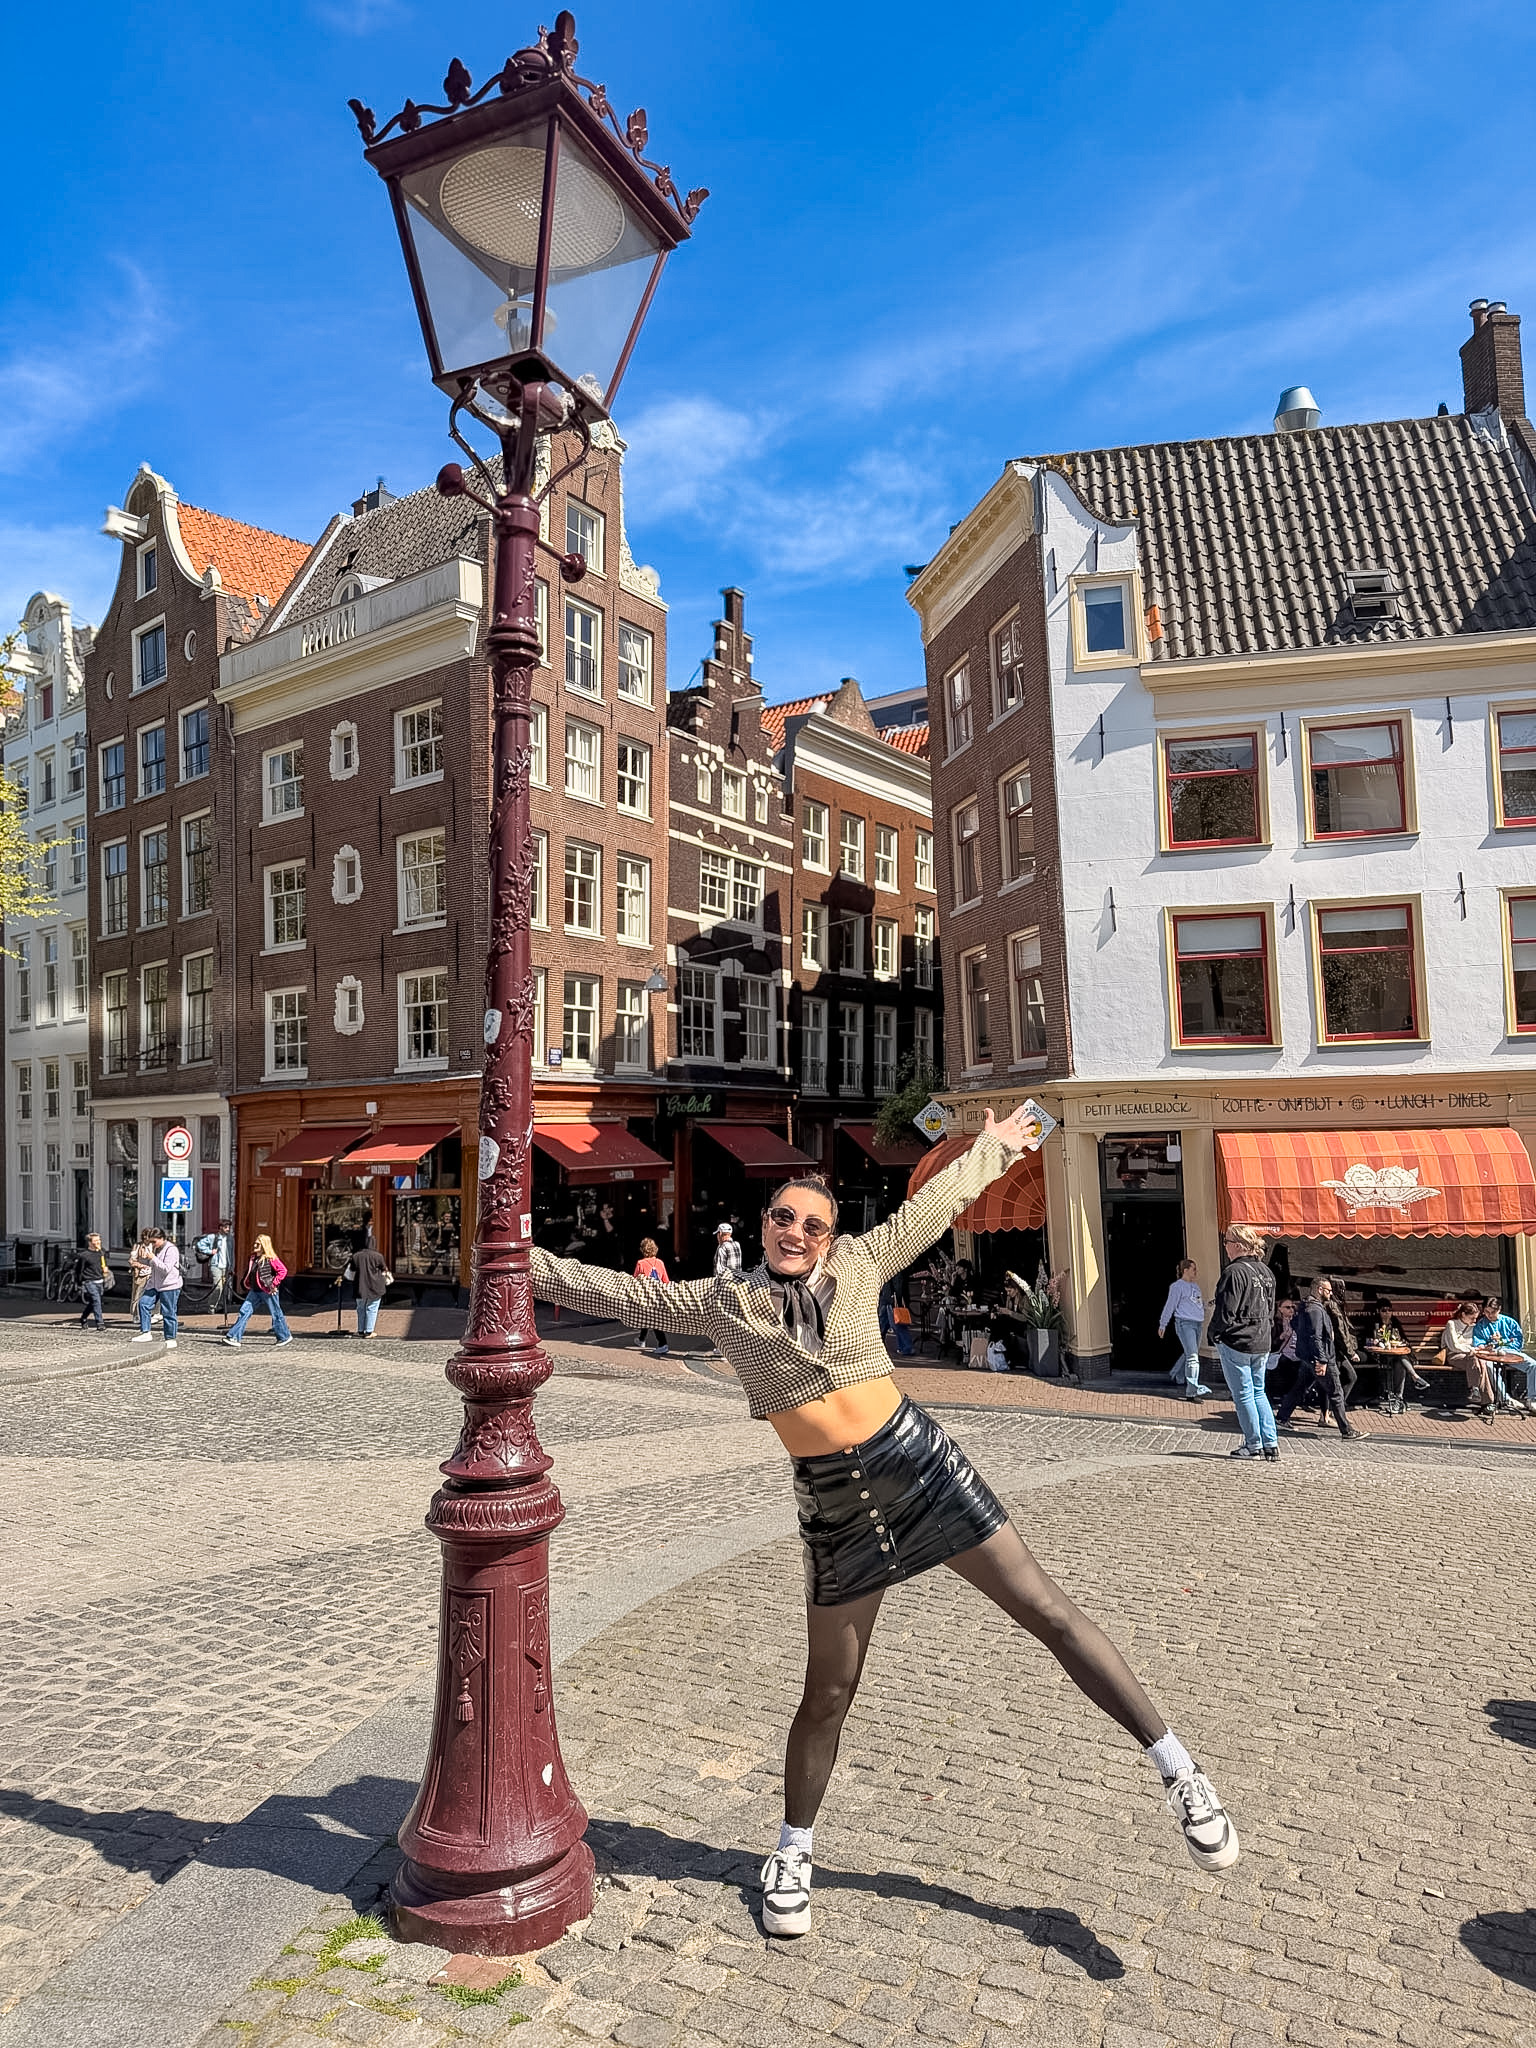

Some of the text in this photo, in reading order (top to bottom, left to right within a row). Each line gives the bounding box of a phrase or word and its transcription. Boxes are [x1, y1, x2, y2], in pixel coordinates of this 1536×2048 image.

[666, 1094, 712, 1117] Grolsch
[1085, 1102, 1192, 1116] PETIT HEEMELRIJCK
[1387, 1094, 1435, 1109] LUNCH
